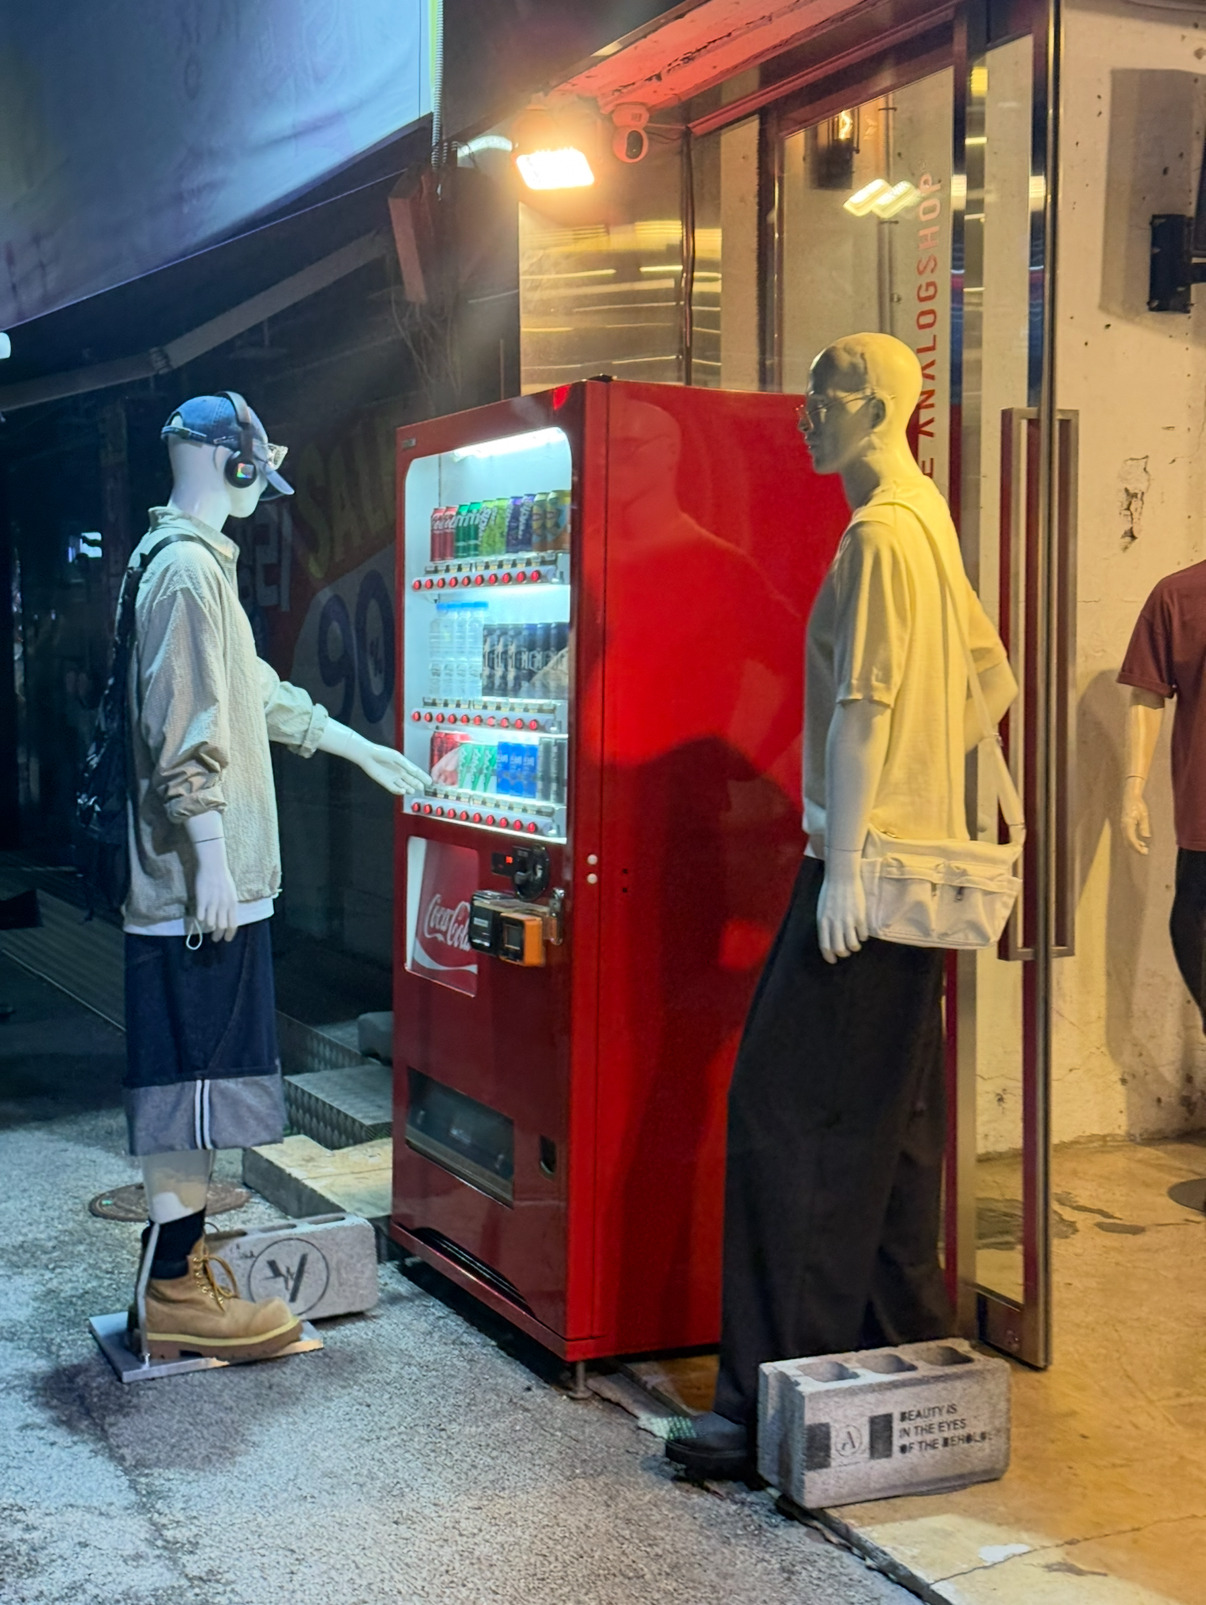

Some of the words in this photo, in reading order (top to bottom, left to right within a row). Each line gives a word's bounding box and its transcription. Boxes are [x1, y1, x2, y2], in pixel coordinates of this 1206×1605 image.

[900, 1405, 945, 1422] BEAUTY
[946, 1403, 958, 1415] IS
[899, 1427, 911, 1438] IN
[914, 1423, 936, 1437] THE
[938, 1418, 967, 1433] EYES
[900, 1442, 915, 1454] OF
[918, 1439, 939, 1451] THE
